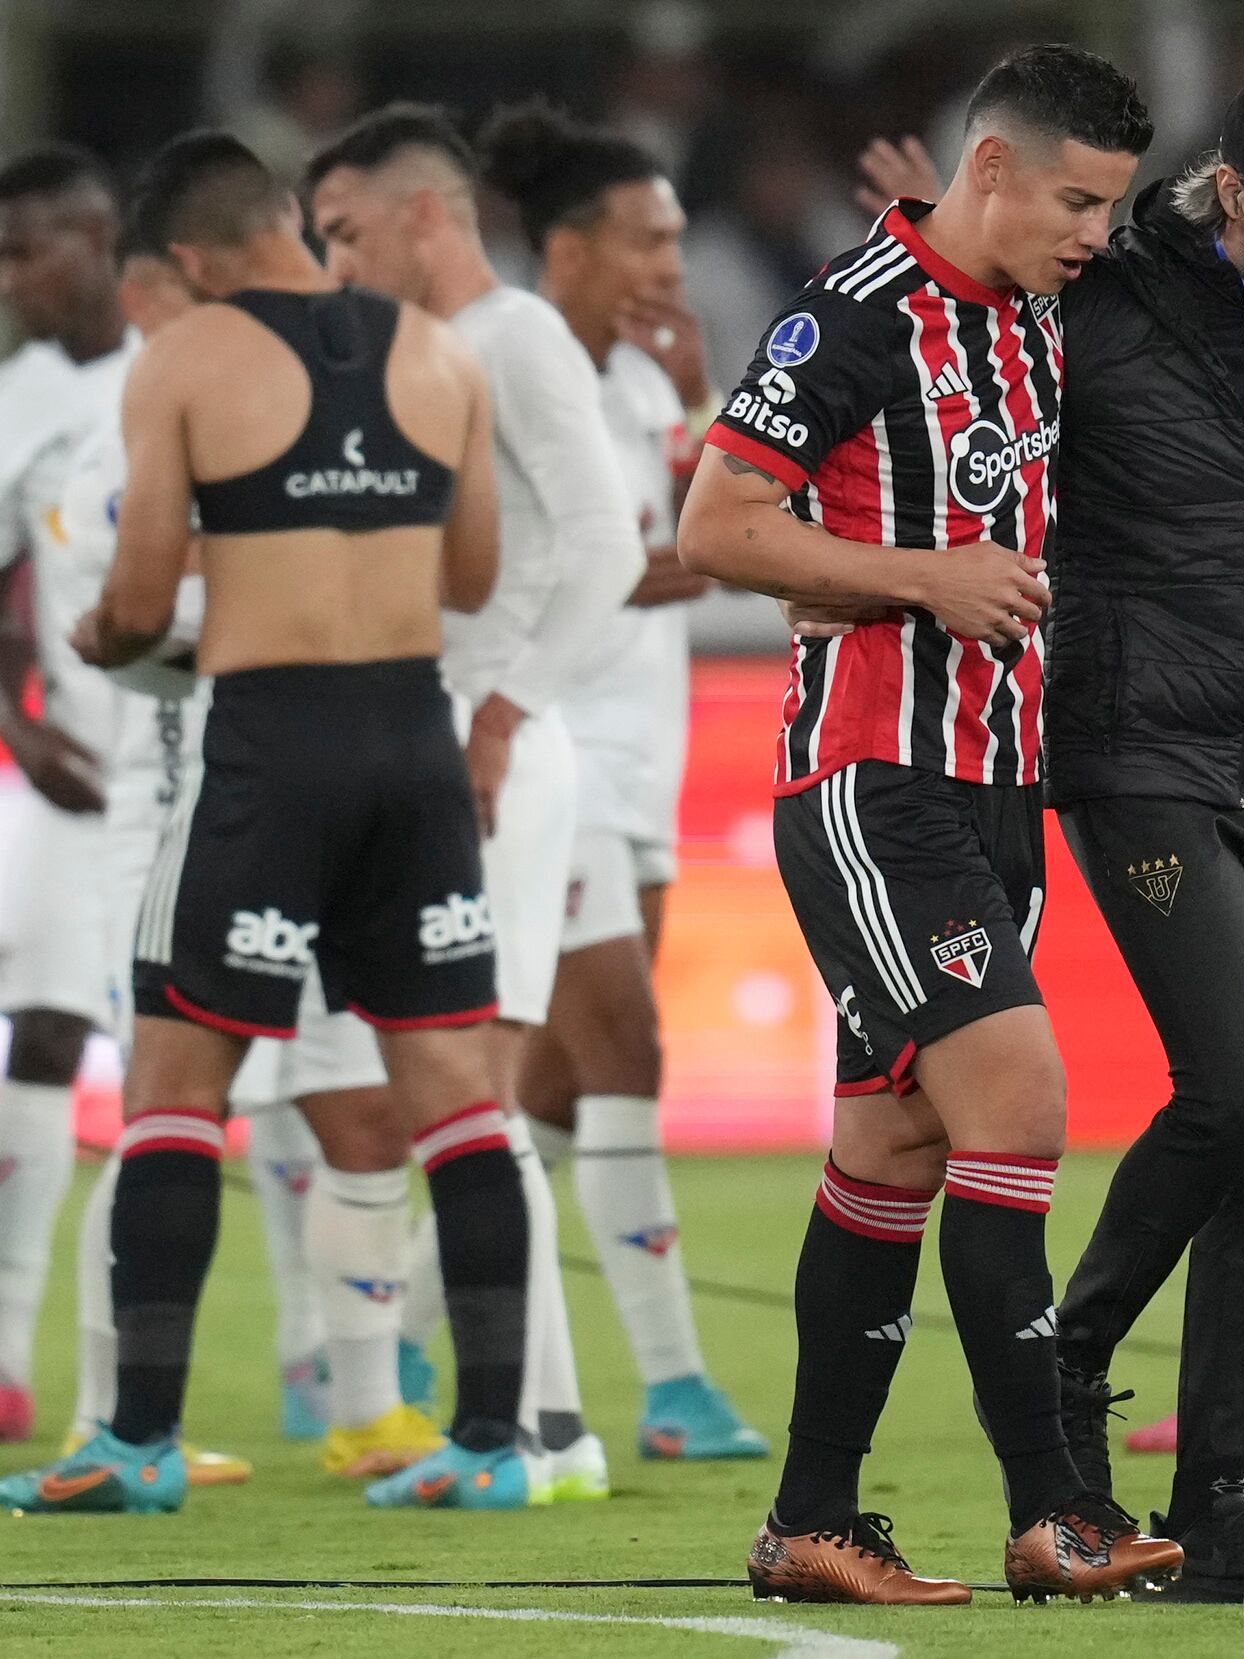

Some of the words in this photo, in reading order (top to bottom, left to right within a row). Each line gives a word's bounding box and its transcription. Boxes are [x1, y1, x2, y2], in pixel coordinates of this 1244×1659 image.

[726, 391, 809, 448] Bitso
[285, 467, 420, 498] CATAPULT
[938, 933, 984, 961] SPFC
